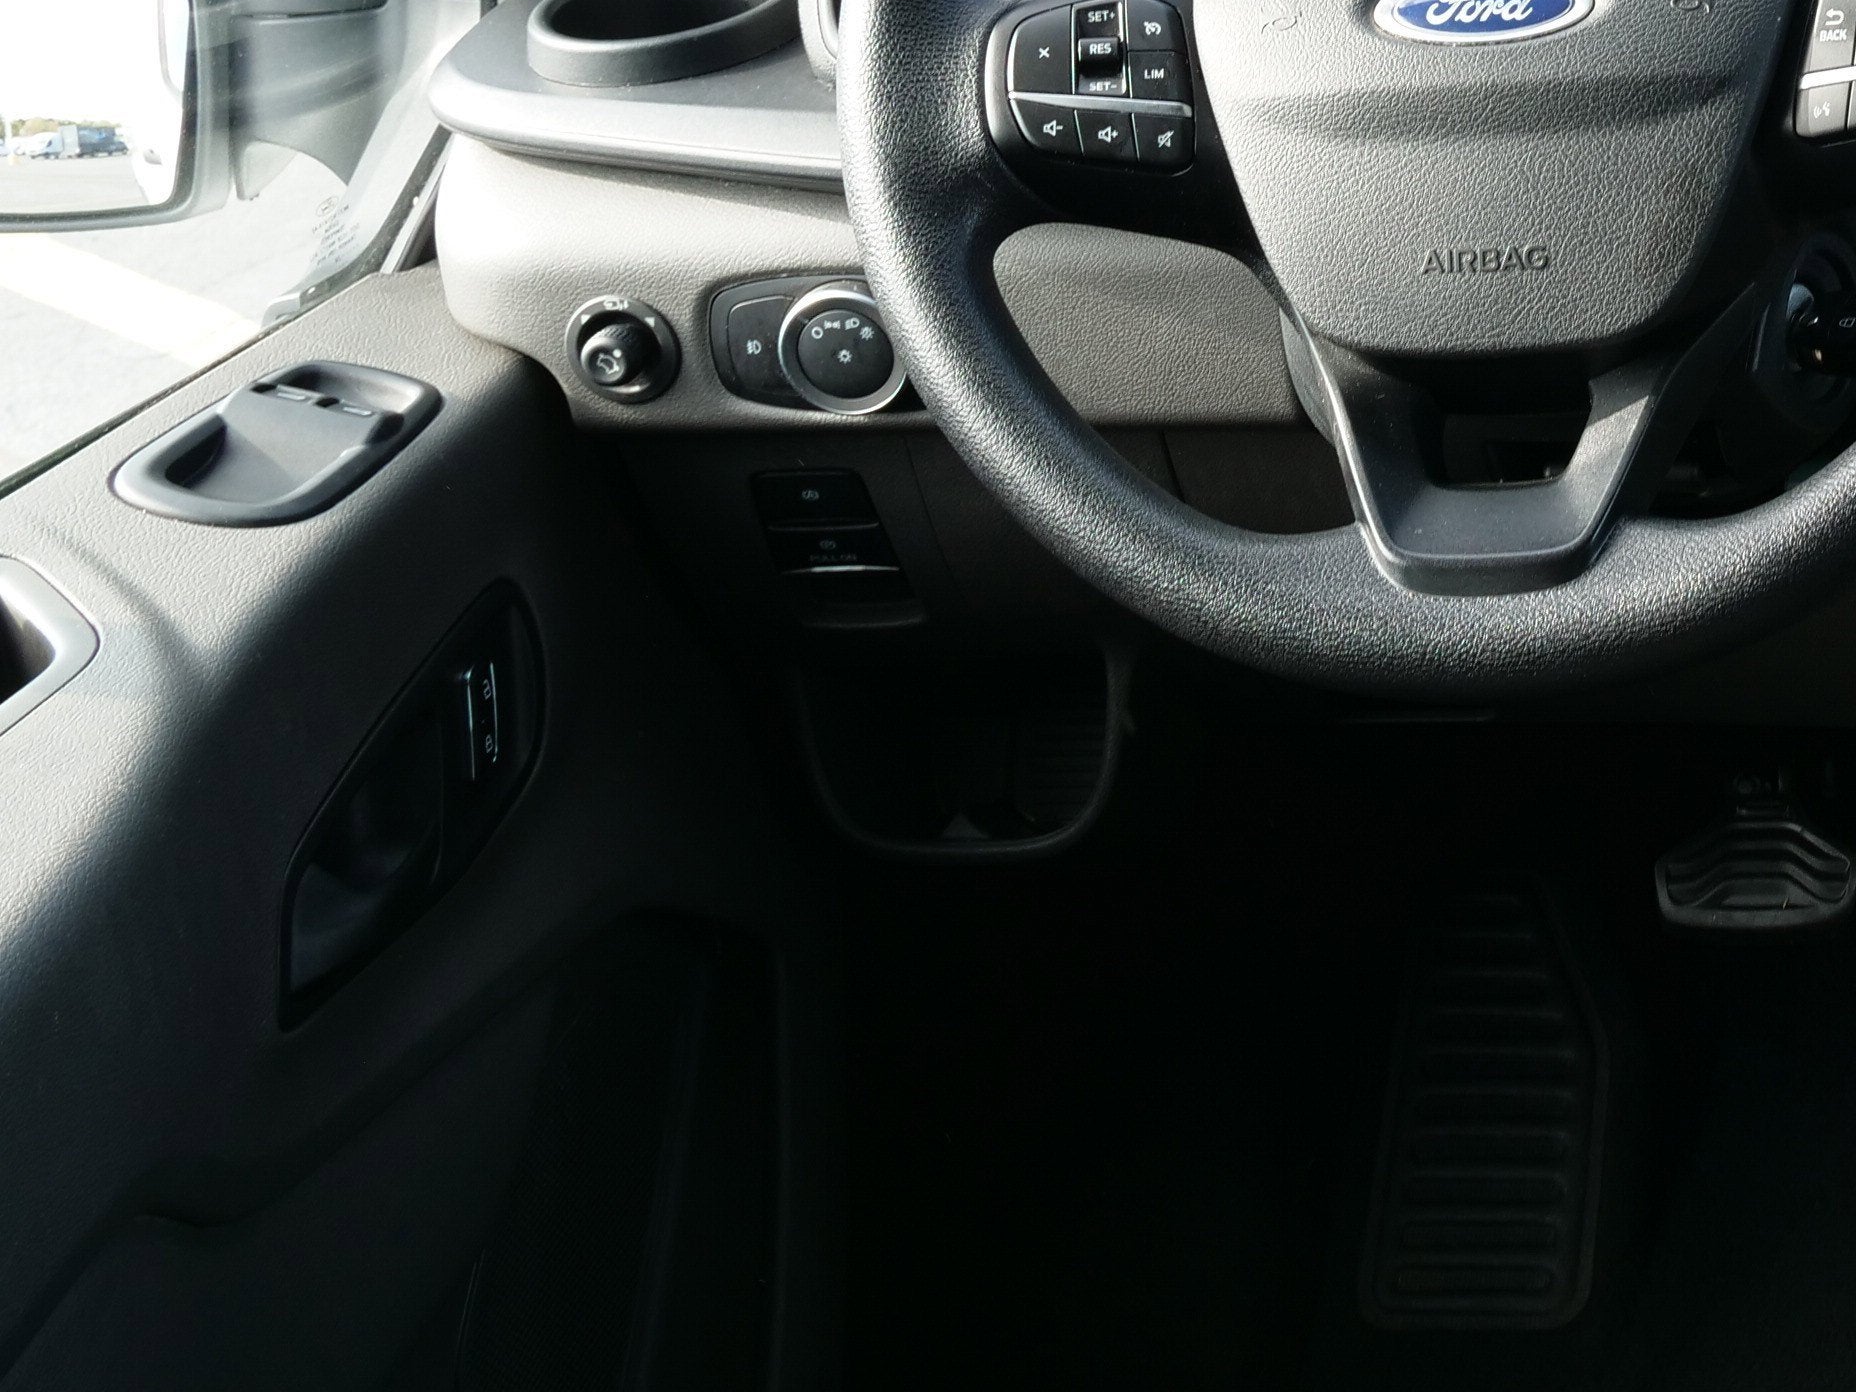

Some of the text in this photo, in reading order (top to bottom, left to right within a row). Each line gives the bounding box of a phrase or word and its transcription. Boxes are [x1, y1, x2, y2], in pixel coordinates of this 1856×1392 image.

[1087, 9, 1116, 24] SET+
[1819, 29, 1848, 42] BACK
[1089, 42, 1112, 55] RES
[1144, 68, 1165, 80] LIM
[1420, 245, 1551, 274] AIRBAG
